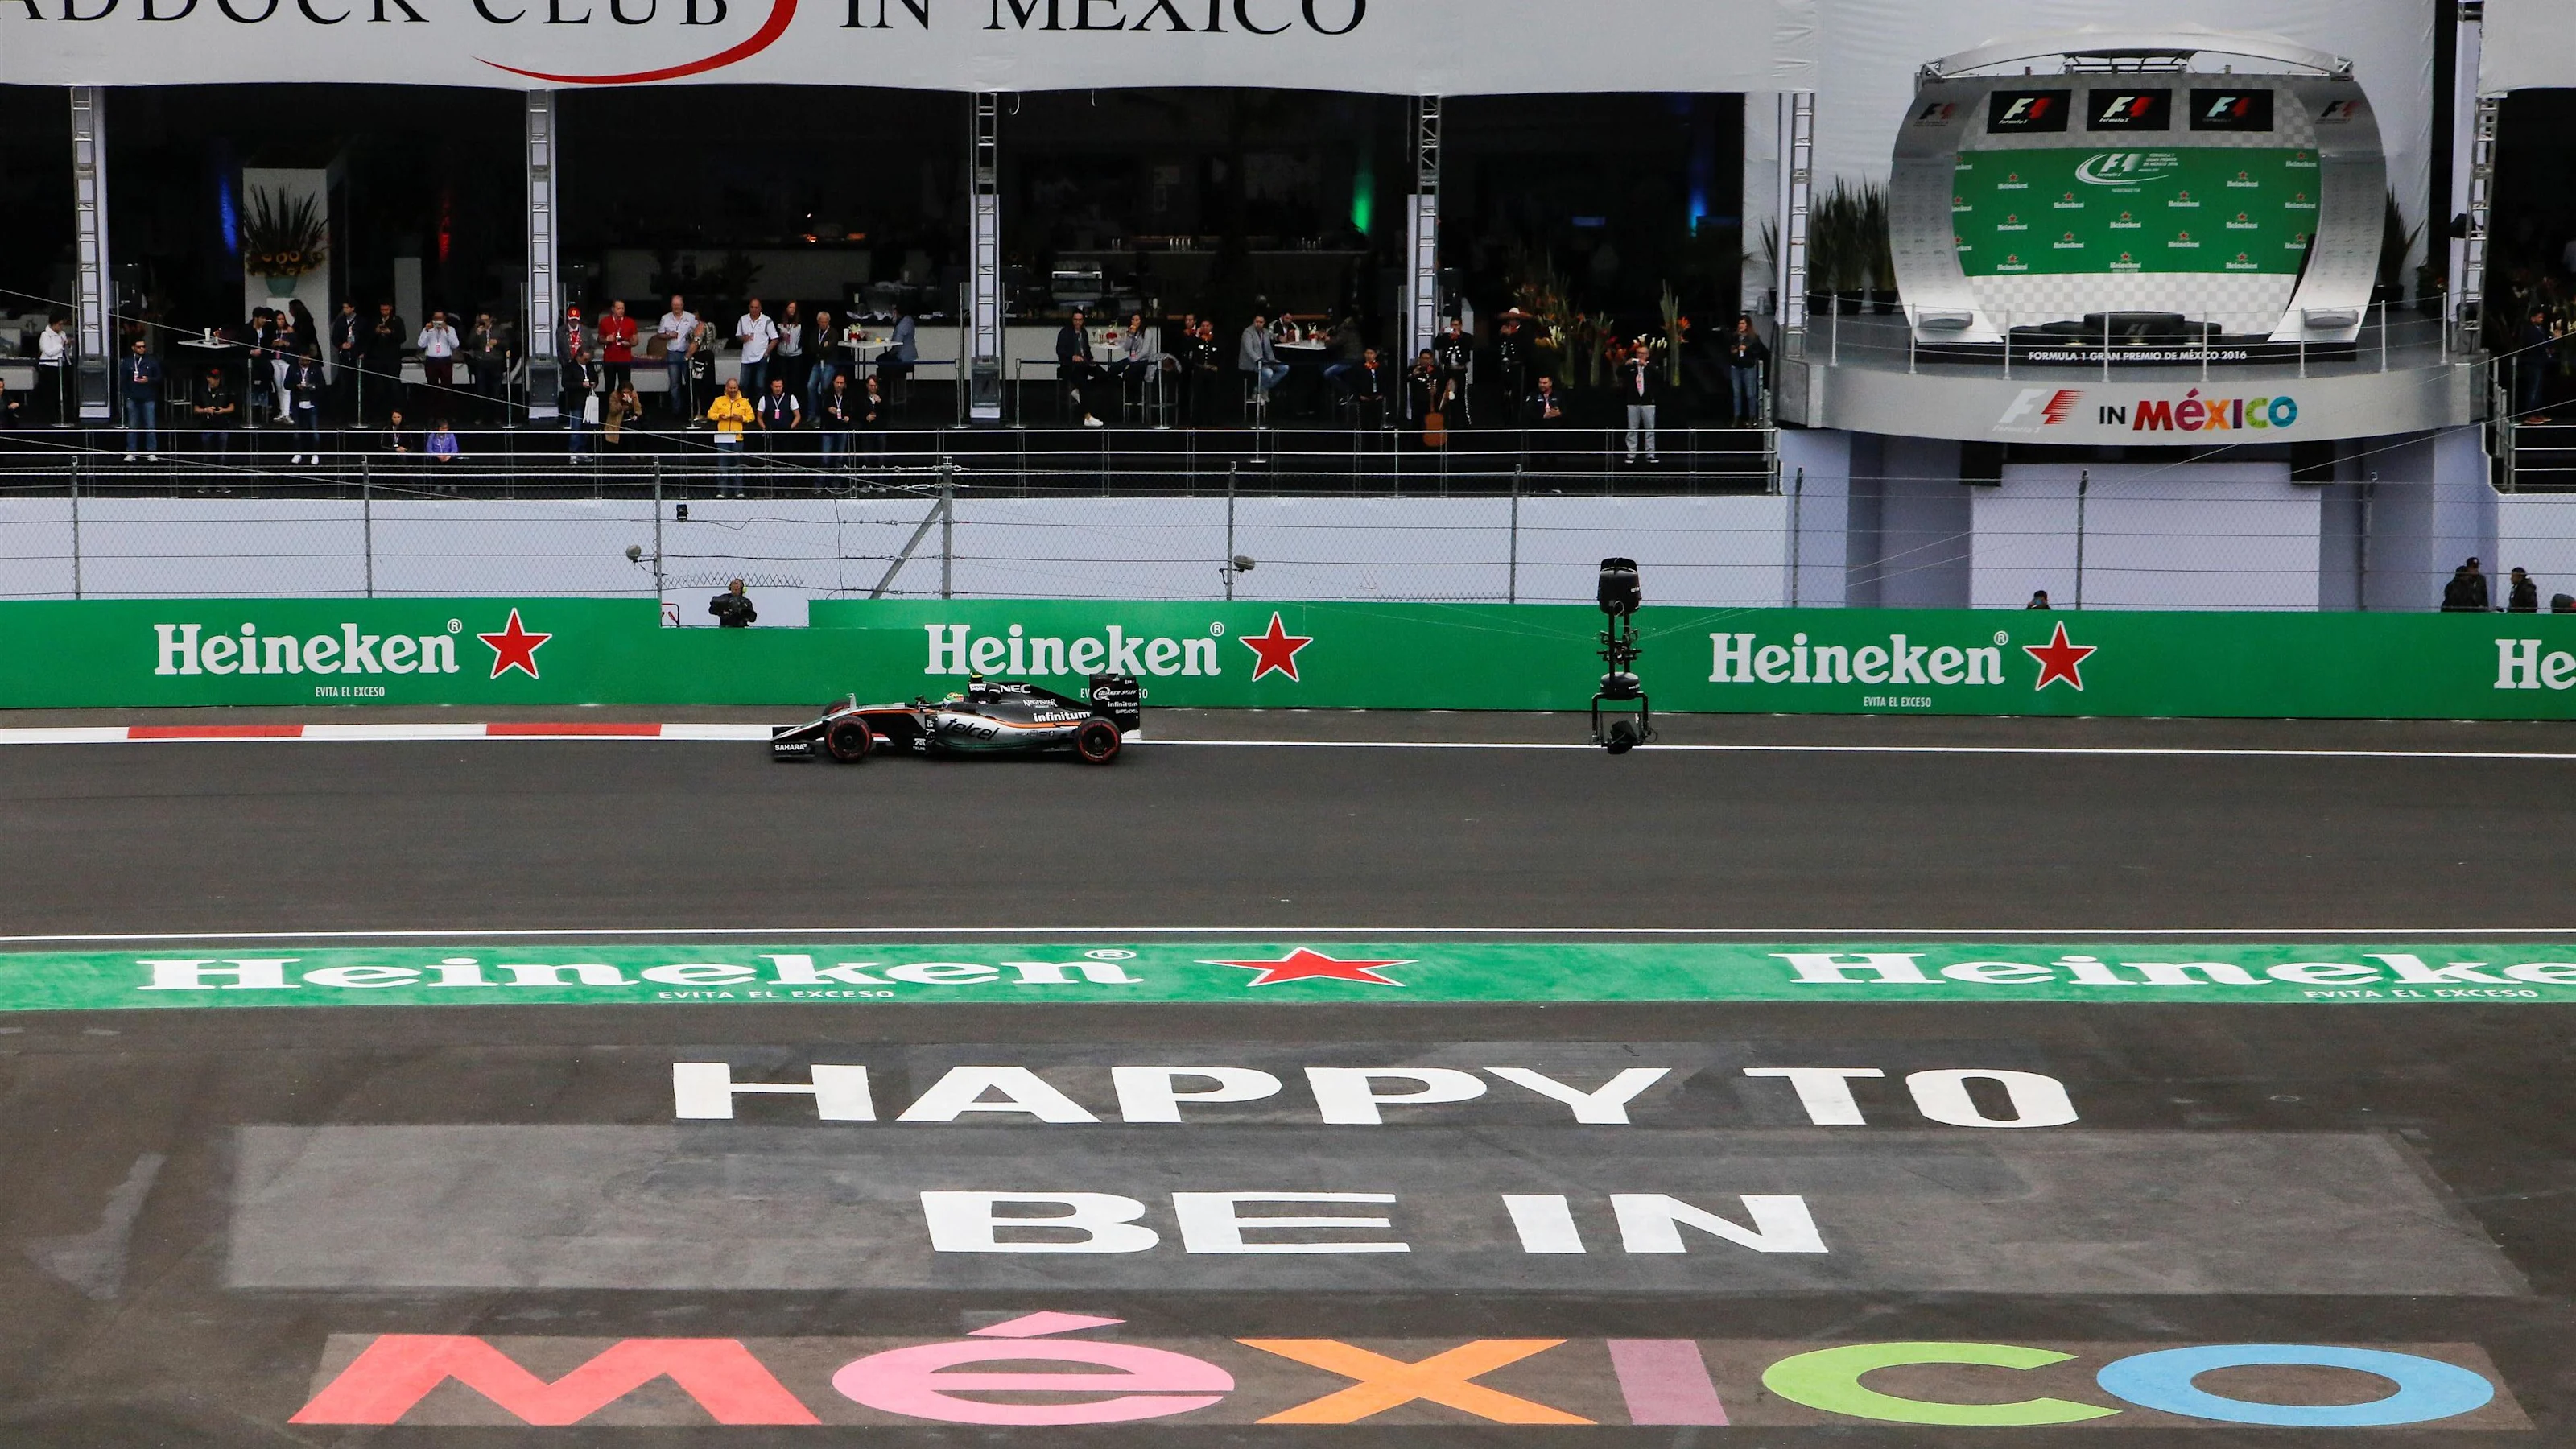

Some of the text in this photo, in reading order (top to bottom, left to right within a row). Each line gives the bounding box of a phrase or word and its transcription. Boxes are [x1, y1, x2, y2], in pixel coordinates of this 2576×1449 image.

[2029, 351, 2077, 361] FORMULA
[2080, 352, 2085, 360] 1
[2090, 352, 2121, 361] GRAN
[2123, 352, 2161, 360] PREMIO
[2164, 351, 2177, 360] DE
[2221, 351, 2247, 359] 2016
[2099, 406, 2126, 424] IN
[154, 621, 460, 675] Heineken
[924, 623, 1222, 677] Heineken
[1708, 633, 2005, 685] Heineken
[316, 687, 385, 697] EVITA EL EXCESO
[1000, 684, 1031, 694] NEC
[1864, 696, 1932, 708] EVITA EL EXCESO
[1033, 711, 1091, 723] infinitum
[944, 718, 1000, 740] telcel
[774, 743, 804, 751] SAHARA
[136, 954, 1144, 991] Heineken
[1768, 952, 2576, 986] Heineke
[659, 990, 894, 1000] EVITA EL EXCESO
[2304, 989, 2539, 999] EVITA EL EXCESO
[672, 1062, 2079, 1128] HAPPY TO
[920, 1191, 1829, 1254] BE IN
